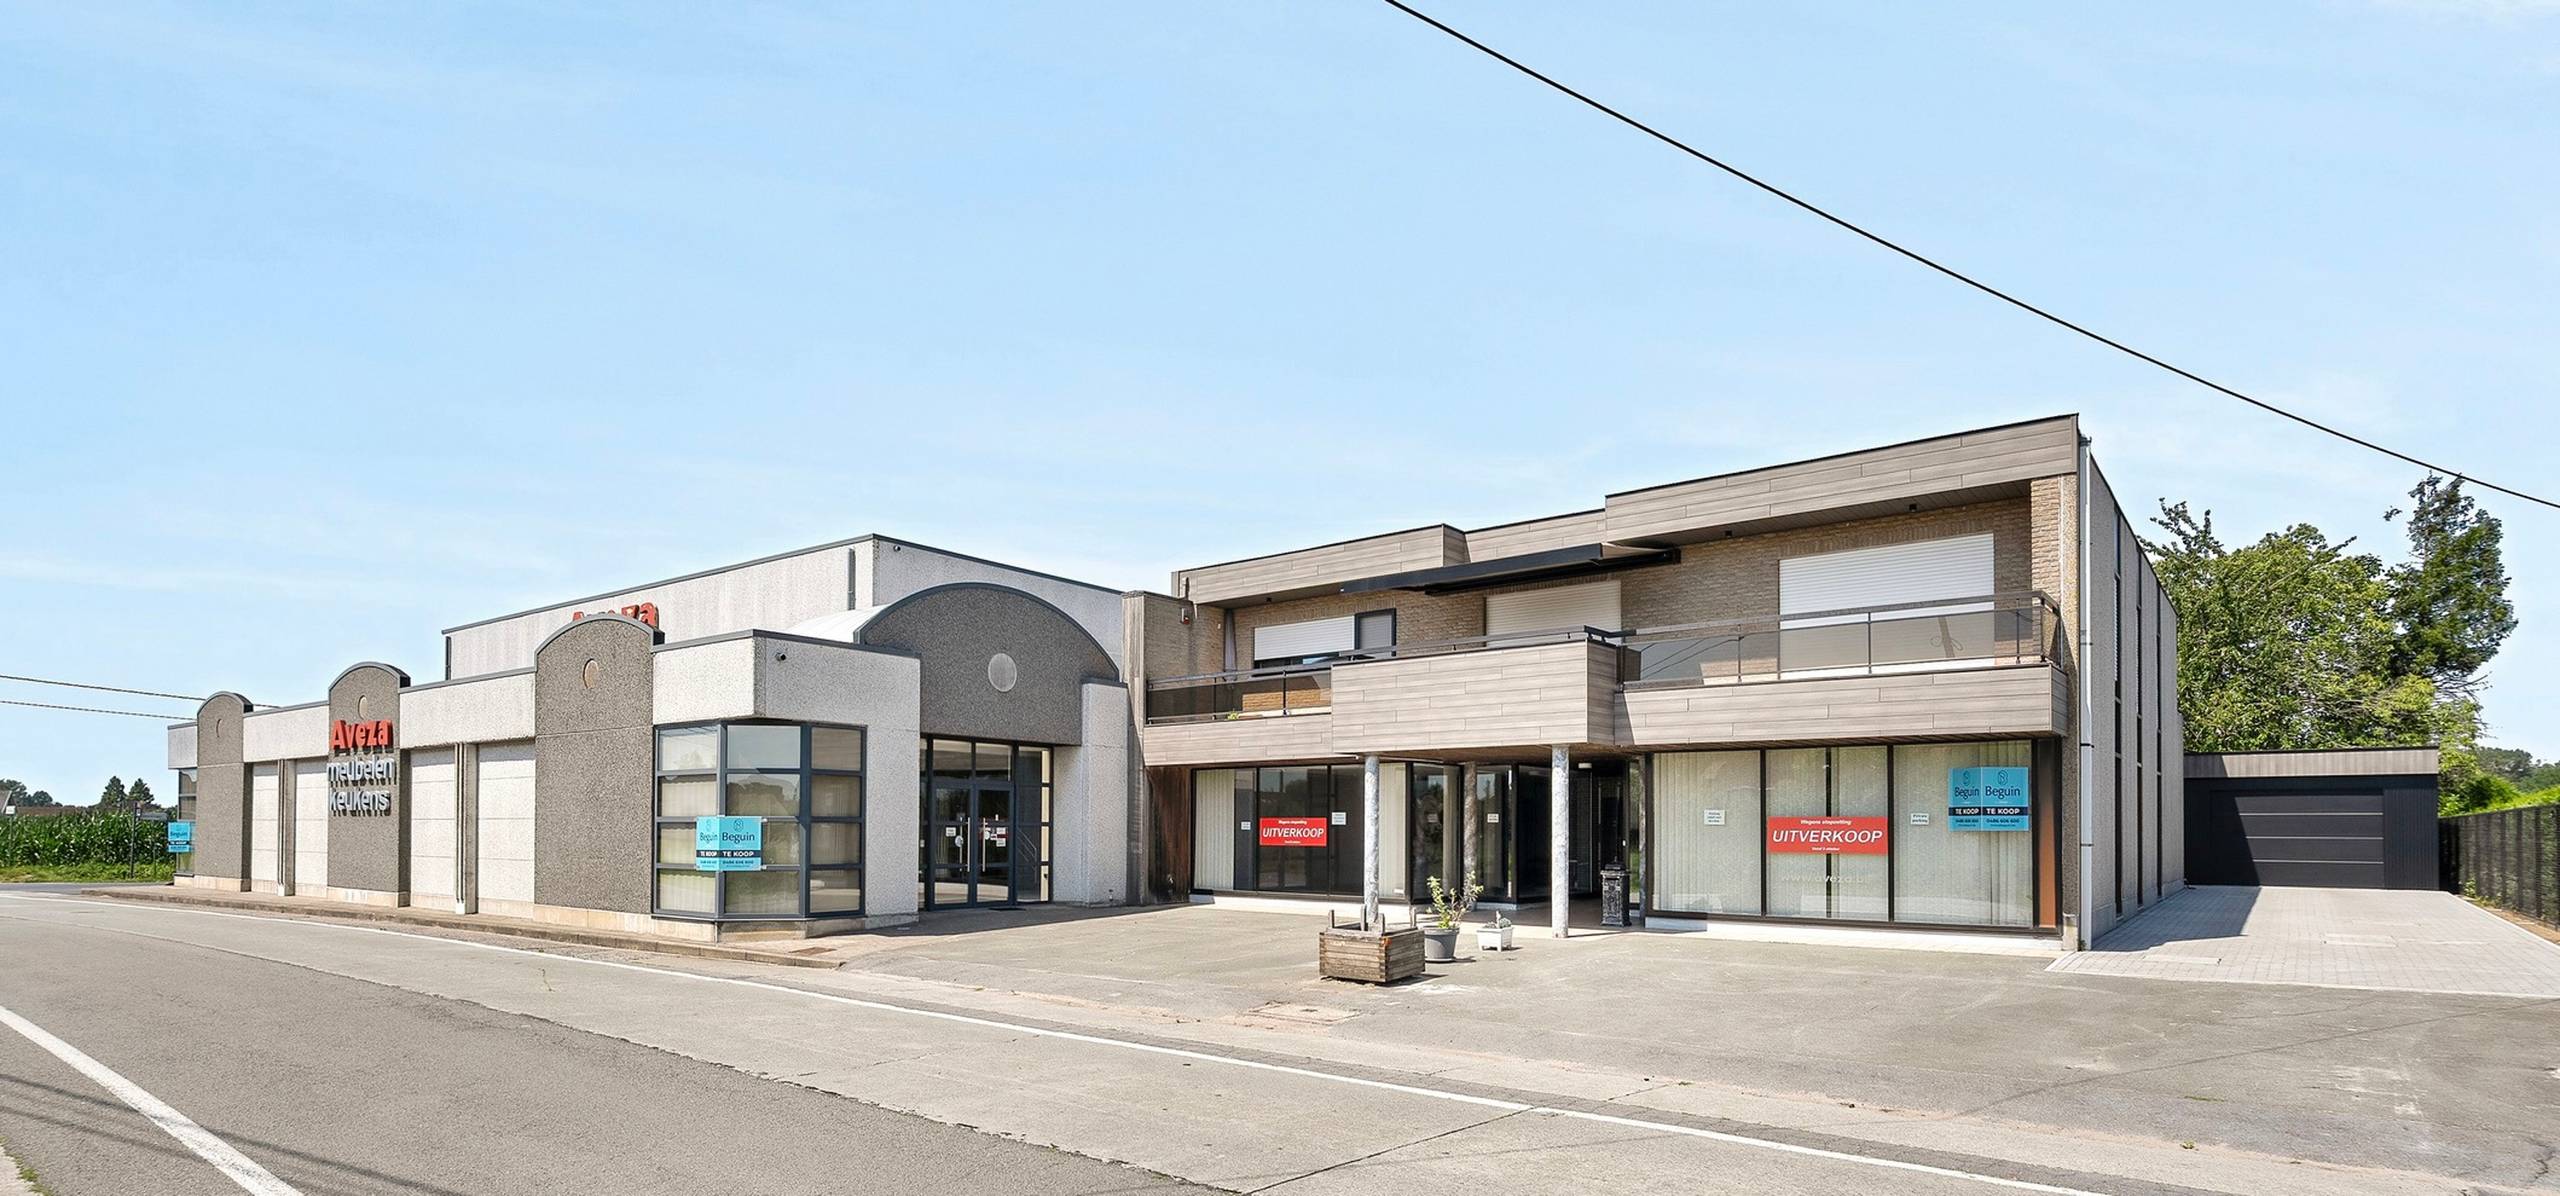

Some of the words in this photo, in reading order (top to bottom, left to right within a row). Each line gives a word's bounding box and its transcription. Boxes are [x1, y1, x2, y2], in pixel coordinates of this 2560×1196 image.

[331, 719, 392, 750] Aveza
[326, 754, 395, 781] meubelen
[329, 786, 391, 811] keukens
[1954, 786, 1980, 800] Beguin
[1985, 785, 2021, 800] Beguin
[722, 831, 755, 844] Beguin
[1262, 827, 1324, 838] UITVERKOOP
[1772, 830, 1883, 843] UITVERKOOP
